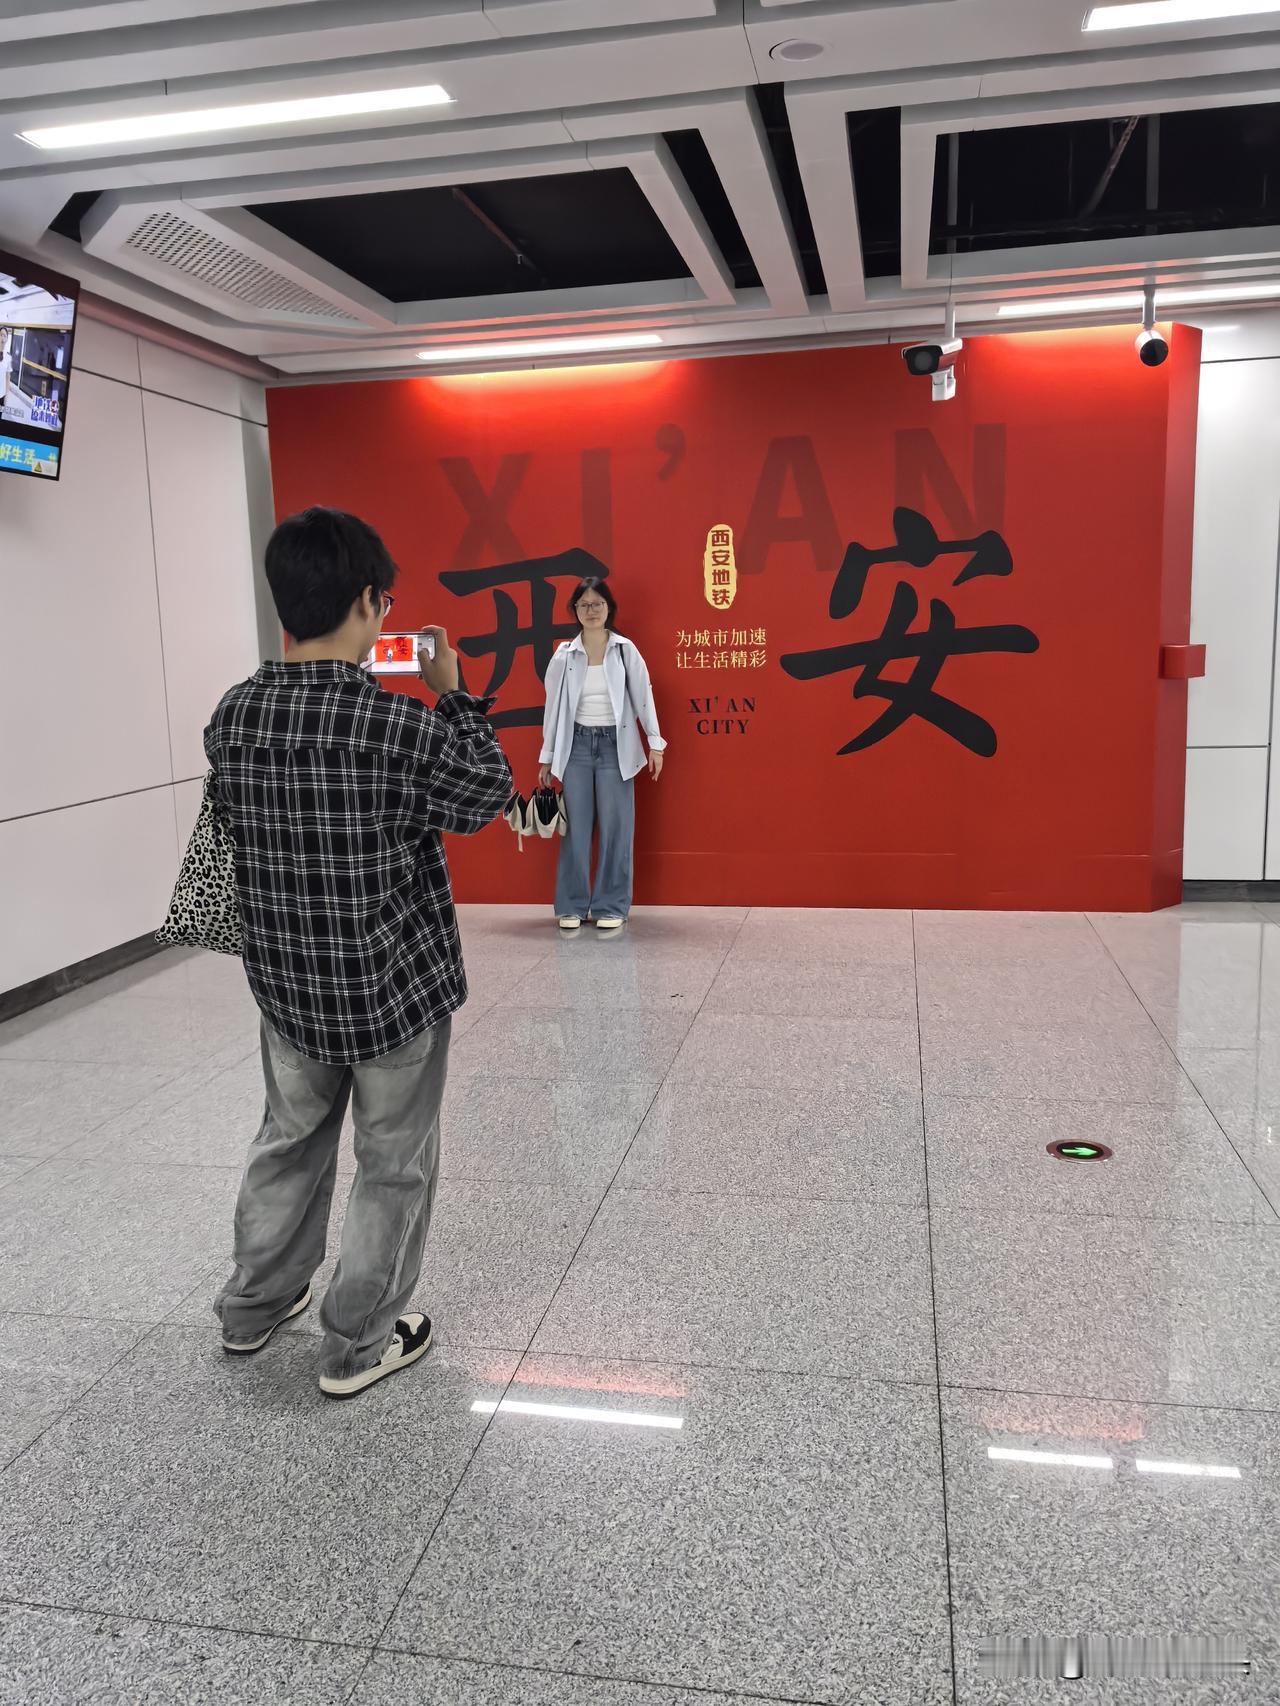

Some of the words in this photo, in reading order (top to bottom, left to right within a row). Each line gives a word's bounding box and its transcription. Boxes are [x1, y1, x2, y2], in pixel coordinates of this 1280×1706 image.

[710, 529, 731, 606] 西安地铁
[676, 628, 767, 648] 为城市加速
[675, 650, 767, 669] 让生活精彩
[696, 719, 749, 735] CITY
